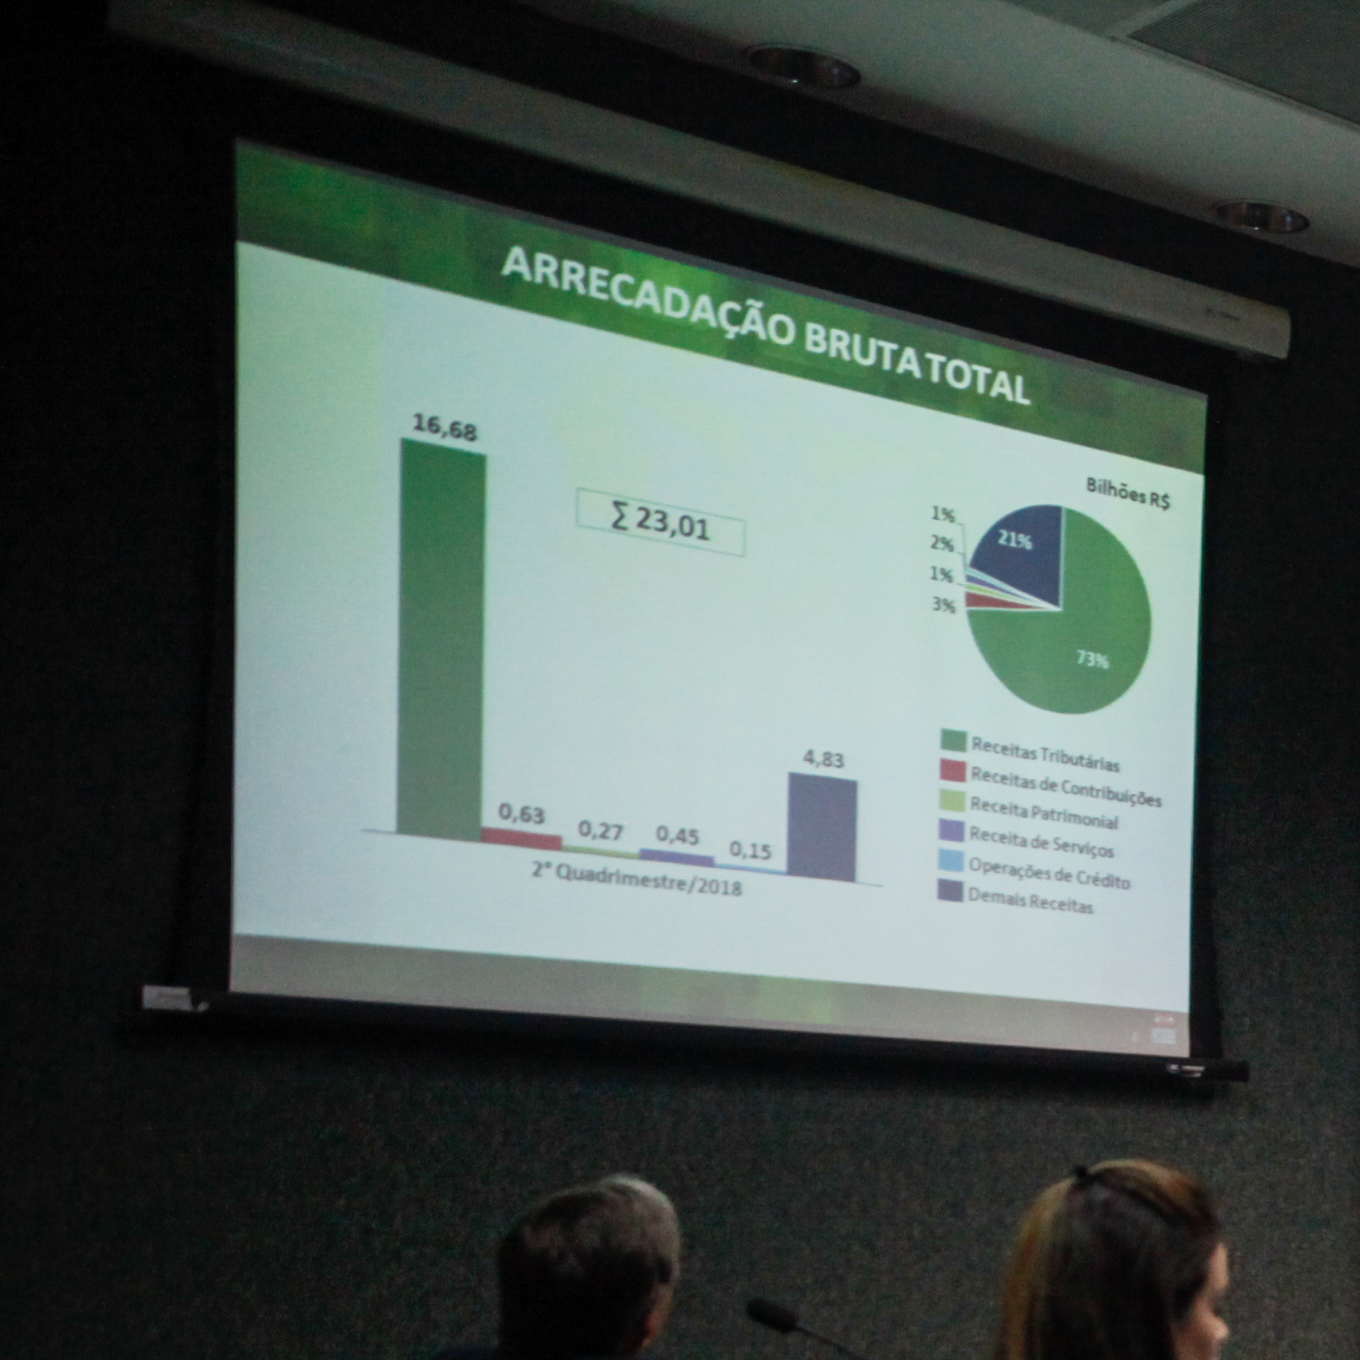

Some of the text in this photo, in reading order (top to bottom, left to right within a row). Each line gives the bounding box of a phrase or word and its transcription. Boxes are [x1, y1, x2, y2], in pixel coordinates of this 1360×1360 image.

[501, 245, 1032, 405] ARRECADAÇÃO BRUTA TOTAL
[412, 412, 478, 442] 16,68
[1086, 476, 1171, 512] Bilhões R$
[636, 506, 710, 541] 23,01
[931, 505, 956, 524] 1%
[930, 534, 955, 554] 2%
[997, 528, 1033, 551] 21%
[930, 566, 954, 584] 1%
[932, 596, 956, 615] 3%
[1076, 649, 1110, 670] 73%
[802, 749, 845, 770] 4,83
[971, 736, 1121, 773] Receitas Tributárias
[970, 766, 1163, 808] Receitas de Contribuições
[498, 802, 545, 826] 0,63
[970, 796, 1119, 831] Receita Patrimonial
[578, 820, 624, 842] 0,27
[656, 825, 700, 847] 0,45
[969, 826, 1115, 860] Receita de Serviços
[729, 841, 772, 861] 0,15
[556, 862, 743, 897] Quadrimestre/2018
[969, 856, 1131, 890] Operações de Crédito
[968, 887, 1094, 915] Demais Receitas
